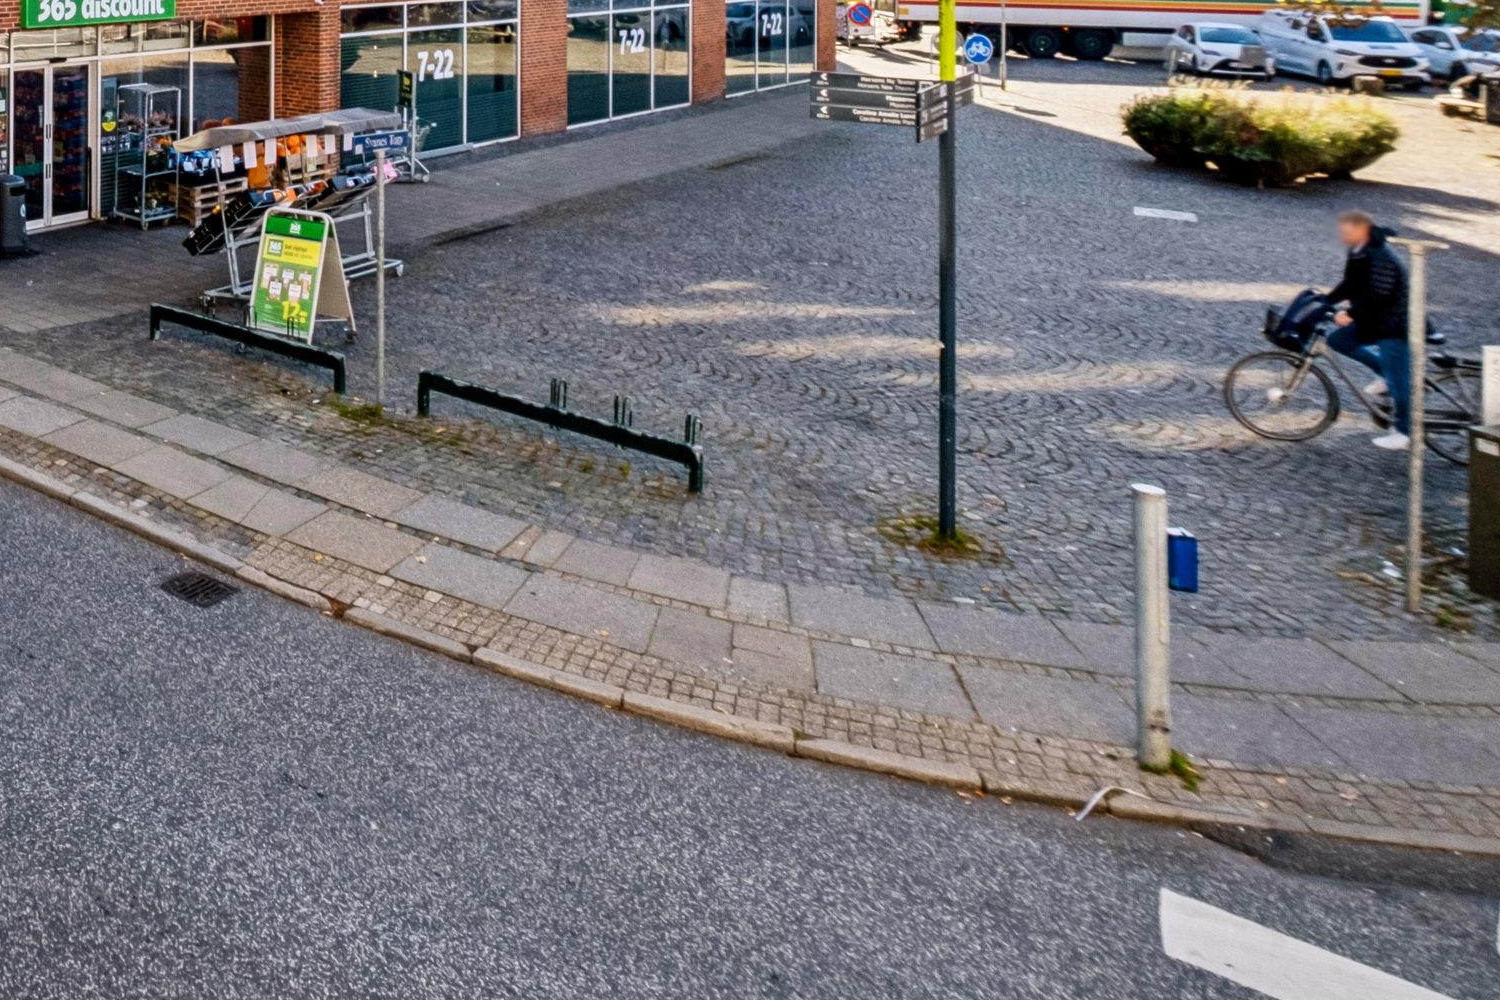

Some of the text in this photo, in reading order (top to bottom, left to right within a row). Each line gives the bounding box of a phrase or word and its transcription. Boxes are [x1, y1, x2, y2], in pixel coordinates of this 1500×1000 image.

[761, 12, 782, 37] 7-22
[619, 27, 645, 56] 7-22
[417, 49, 454, 82] 7-22
